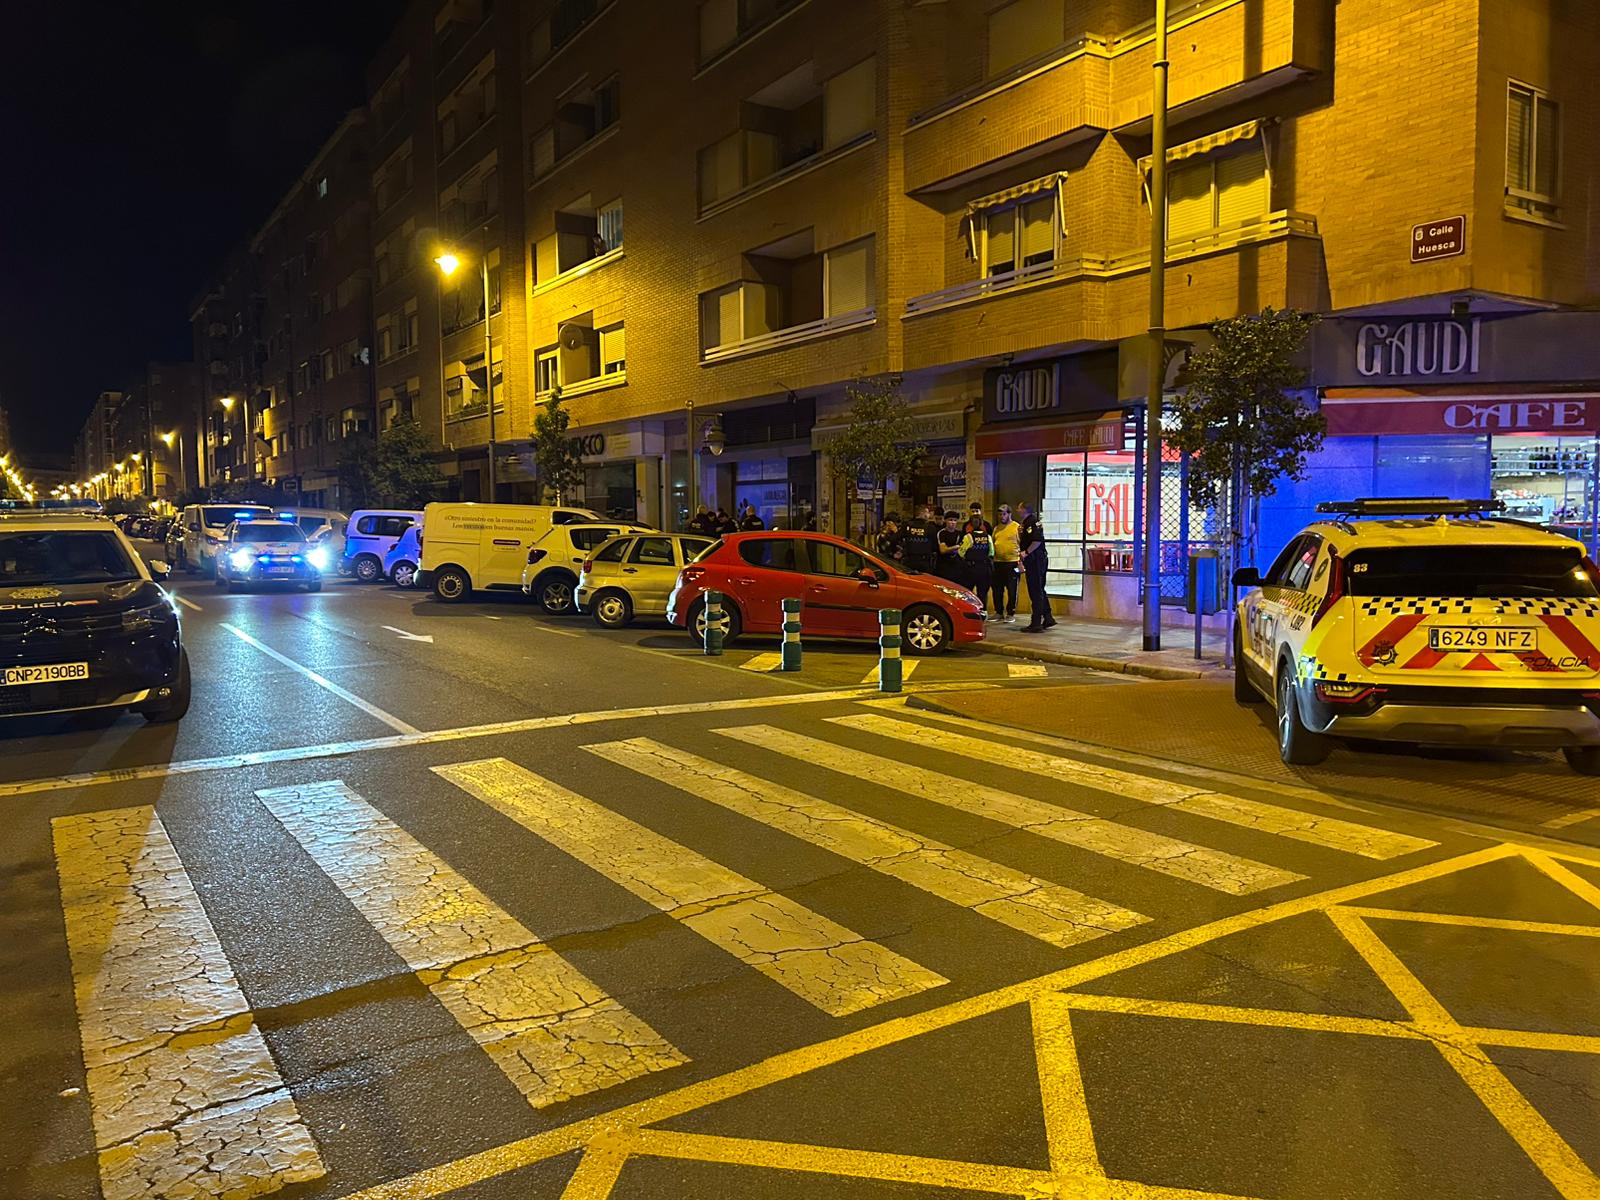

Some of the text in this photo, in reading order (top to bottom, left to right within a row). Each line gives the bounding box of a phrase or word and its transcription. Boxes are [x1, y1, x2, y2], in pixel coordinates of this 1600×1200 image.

[1429, 225, 1454, 237] Calle
[1418, 241, 1455, 254] Huesca
[1356, 317, 1481, 376] GAUDI
[996, 362, 1060, 413] GAUDI
[1443, 402, 1586, 429] CAFE
[1089, 425, 1115, 445] GAUDI
[1353, 563, 1369, 573] 83
[1442, 631, 1531, 647] 6249 NFZ
[6, 664, 86, 683] CNP2190BB
